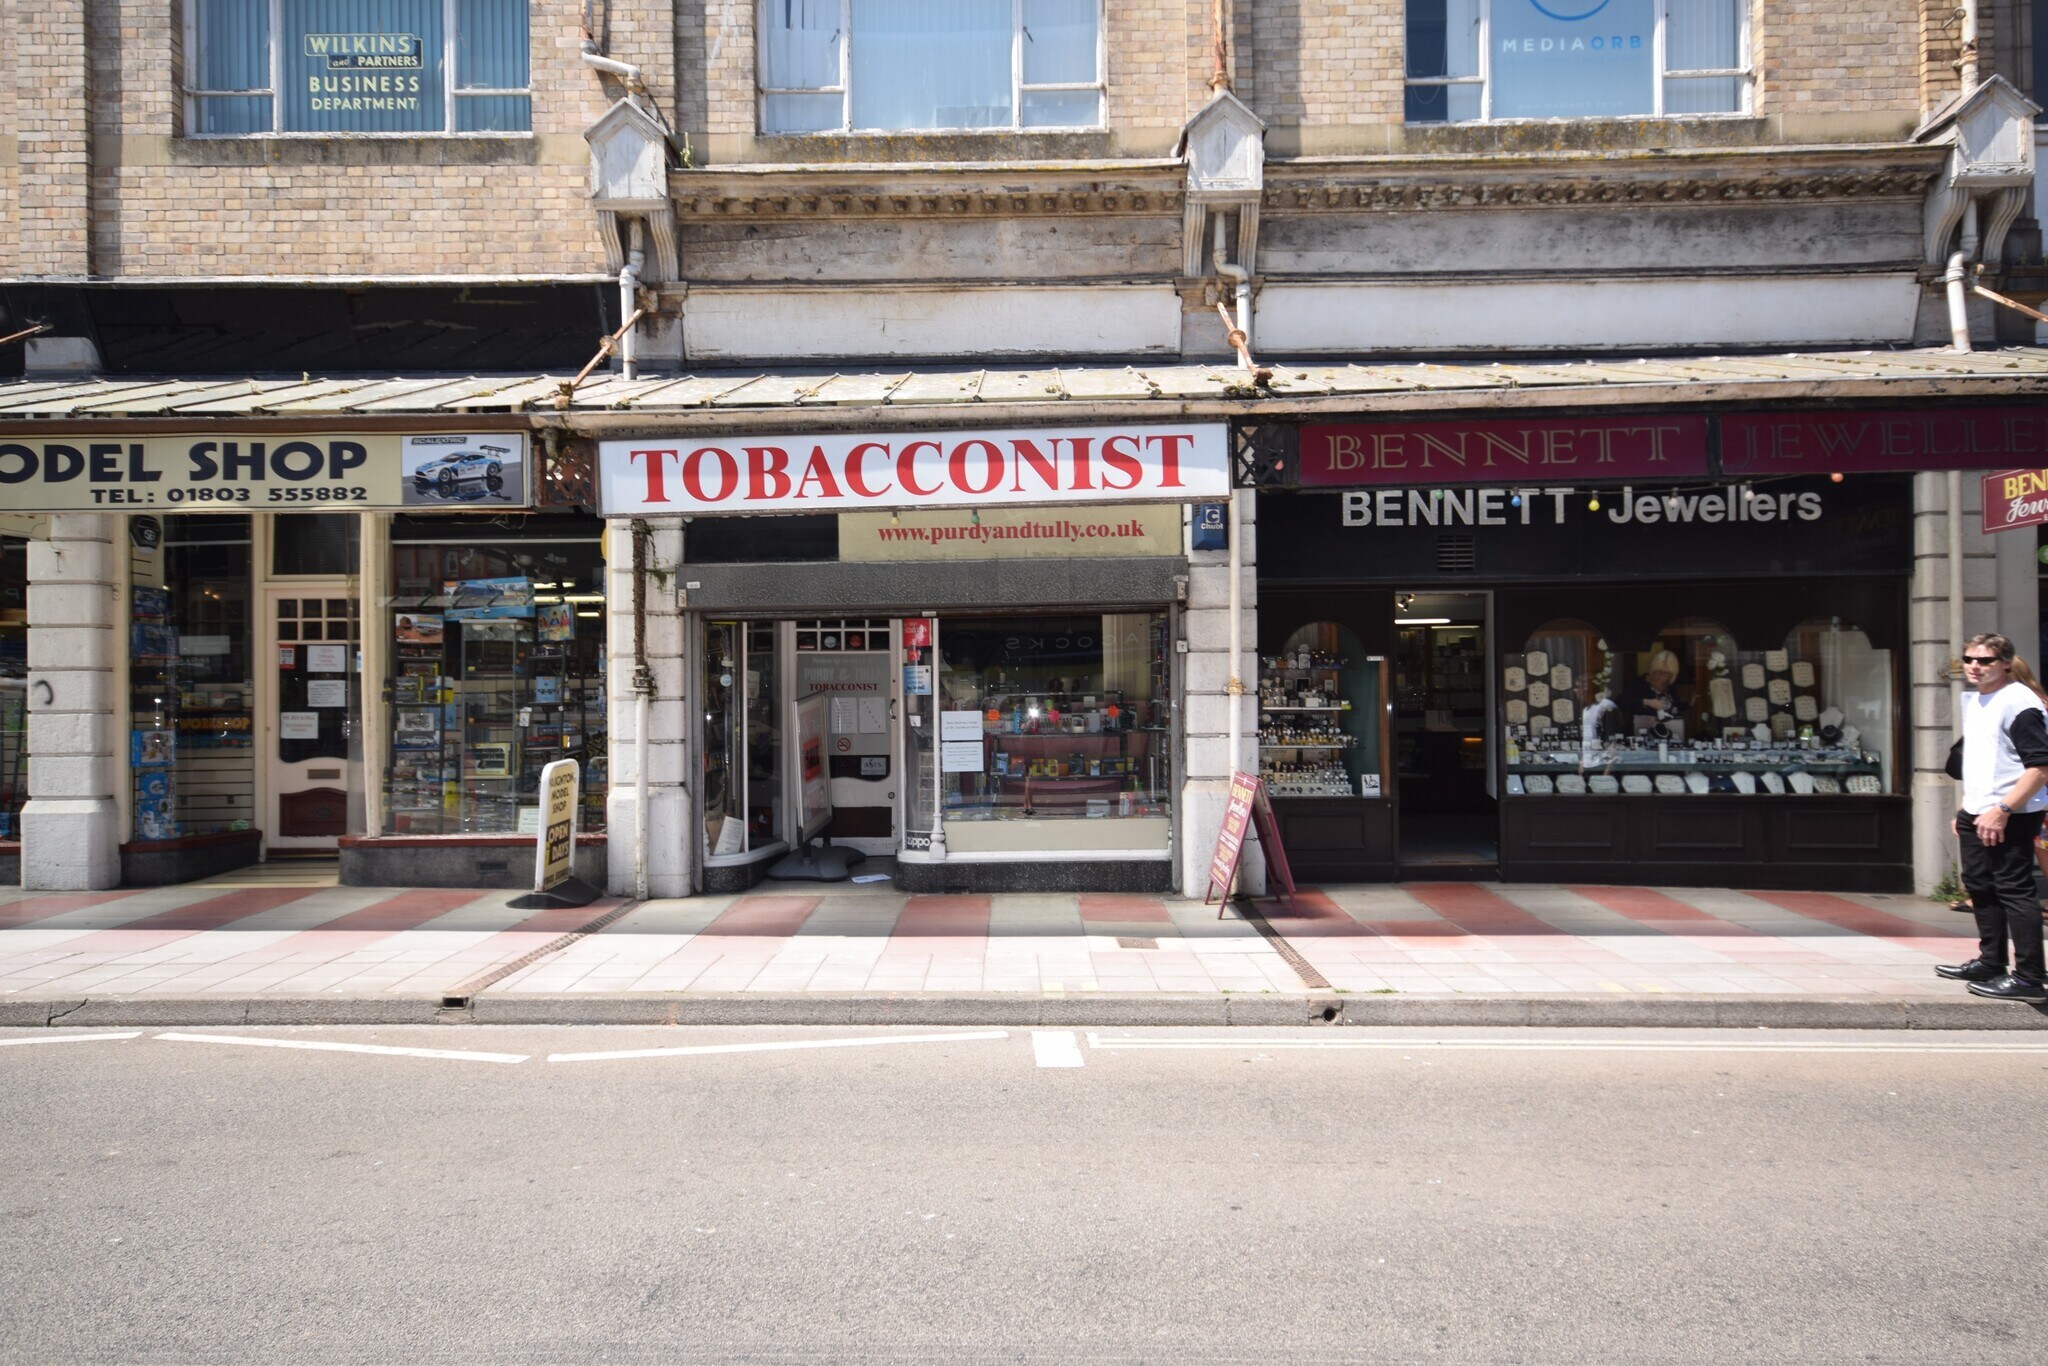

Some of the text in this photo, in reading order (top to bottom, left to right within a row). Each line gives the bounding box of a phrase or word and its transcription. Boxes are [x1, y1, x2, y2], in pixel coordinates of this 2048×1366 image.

[309, 36, 411, 54] WILKINS
[331, 56, 418, 67] and PARTNERS
[309, 76, 420, 92] BUSINESS
[311, 98, 418, 110] DEPARTMENT
[412, 437, 466, 445] SCALEXTRIC
[1325, 426, 1681, 471] BENNETT
[0, 441, 367, 484] ODEL SHOP
[630, 434, 1195, 503] TOBACCONIST
[90, 487, 368, 503] TEL: 01803 555882
[1342, 485, 1823, 527] BENNETT Jewellers
[878, 519, 1145, 544] www.purdyandtully.co.uk
[809, 682, 879, 691] TOBACCONIST
[180, 717, 250, 730] WORKSHOP
[551, 787, 569, 802] MODEL
[553, 800, 567, 814] SHOP
[548, 823, 569, 844] OPEN
